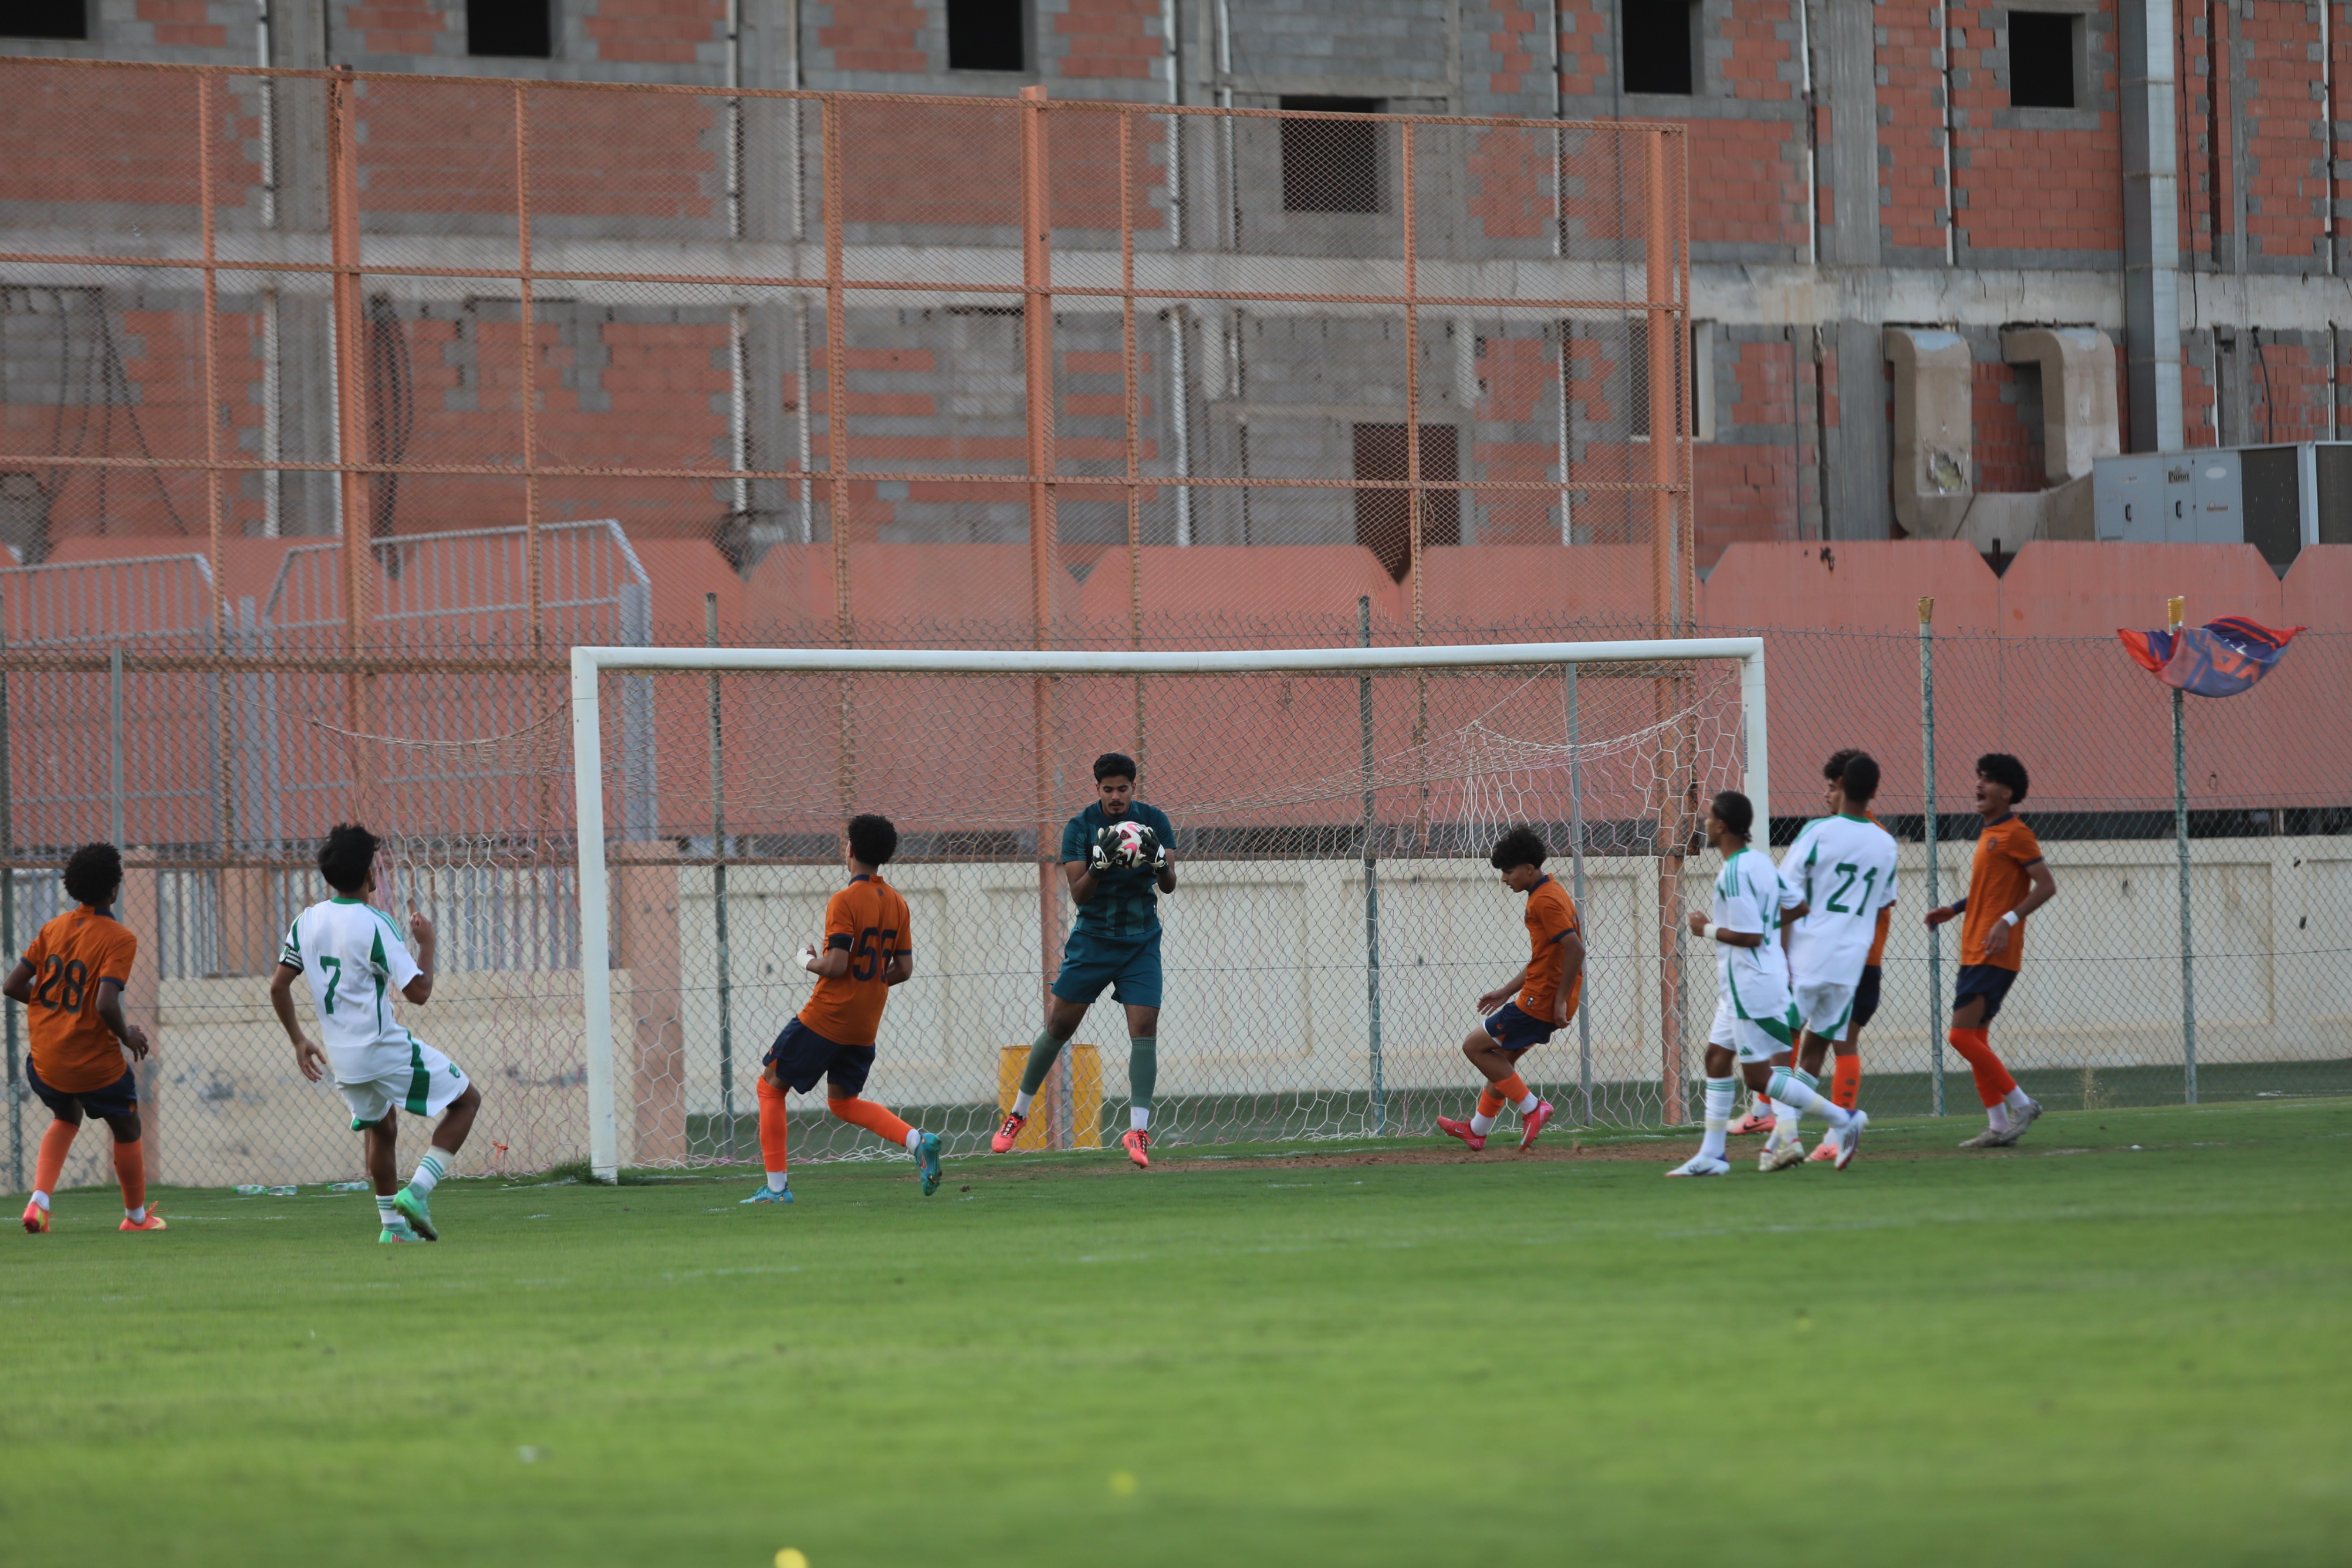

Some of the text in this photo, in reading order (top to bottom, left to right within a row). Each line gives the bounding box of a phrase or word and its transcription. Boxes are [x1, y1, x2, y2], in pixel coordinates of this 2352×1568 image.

[1826, 863, 1878, 916] 21
[39, 954, 87, 1014] 28
[320, 955, 341, 1014] 7
[852, 927, 897, 984] 55
